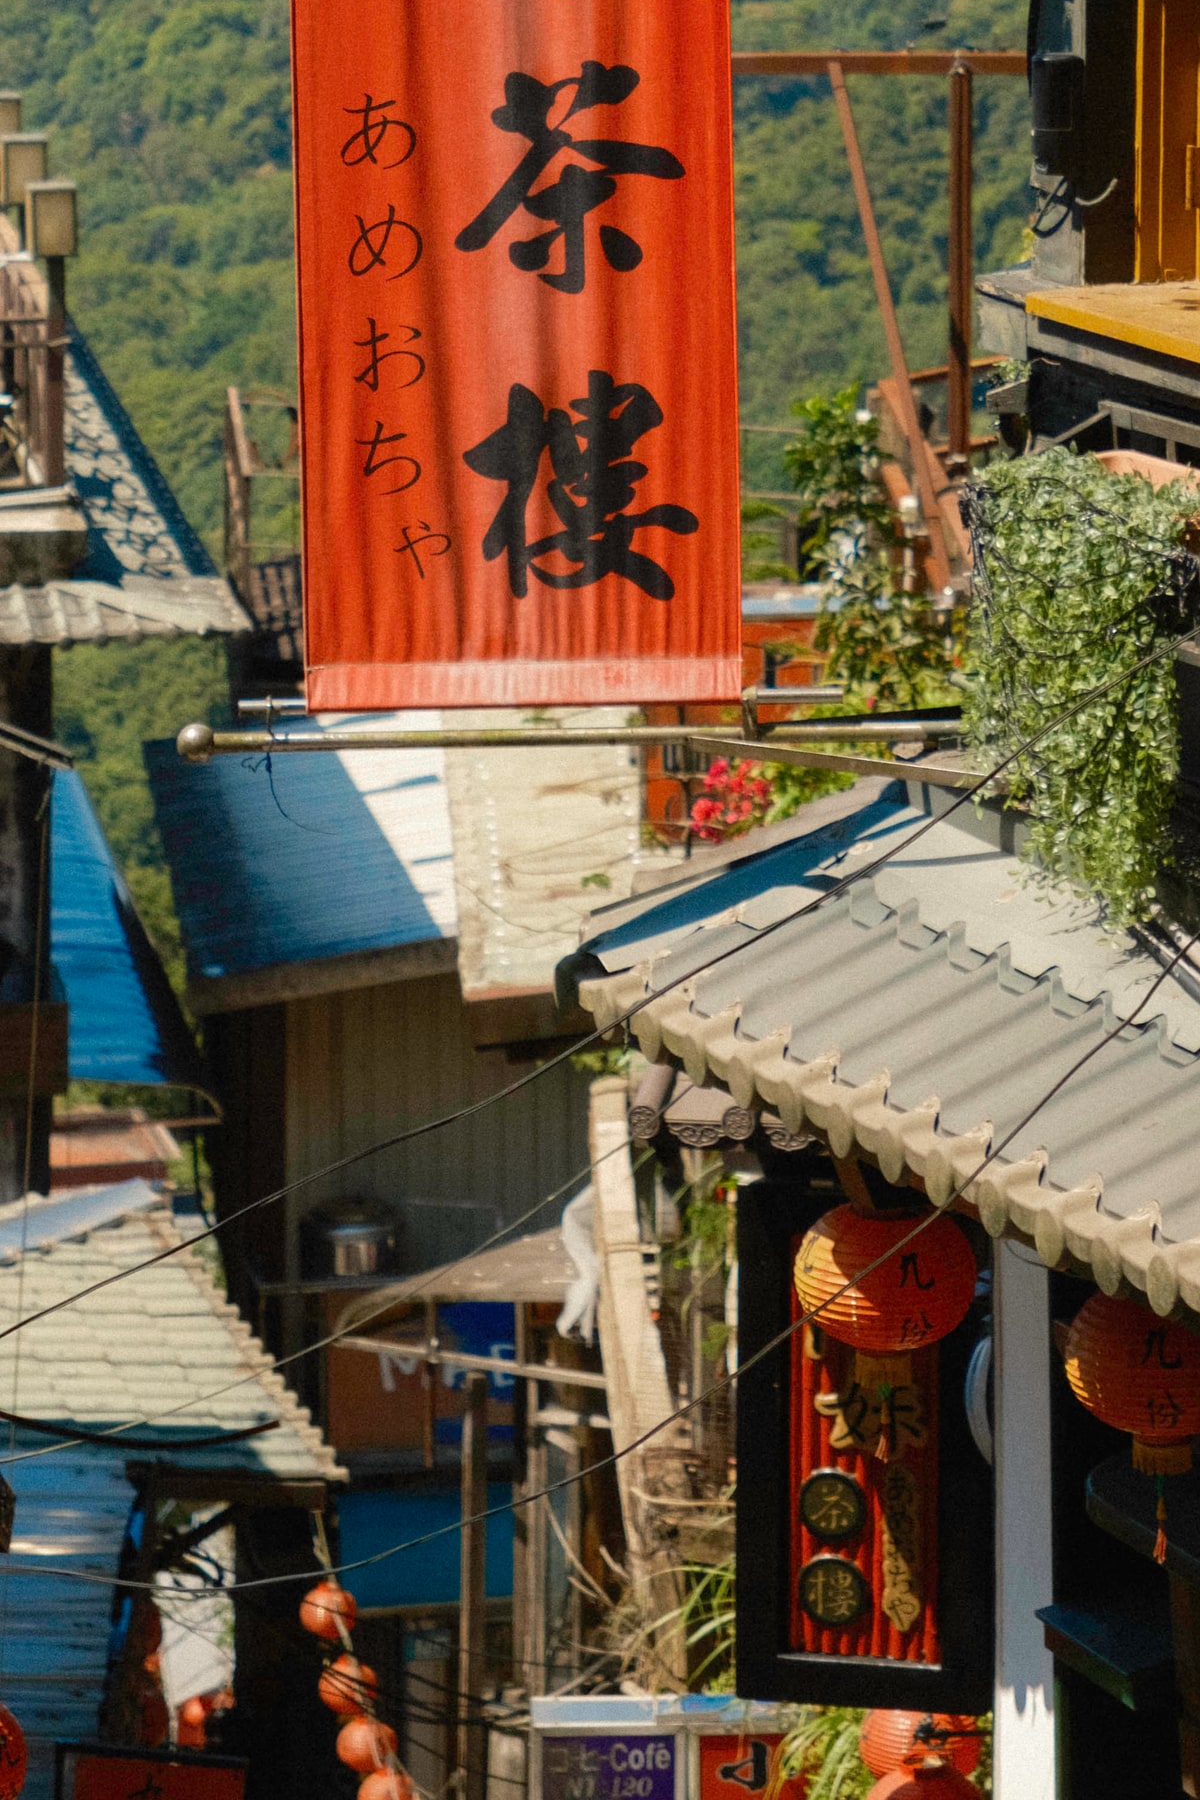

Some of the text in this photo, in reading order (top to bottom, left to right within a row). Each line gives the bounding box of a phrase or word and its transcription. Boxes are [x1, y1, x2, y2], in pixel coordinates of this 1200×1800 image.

[340, 92, 452, 578] あめおちゃ
[1142, 1324, 1185, 1429] 九份
